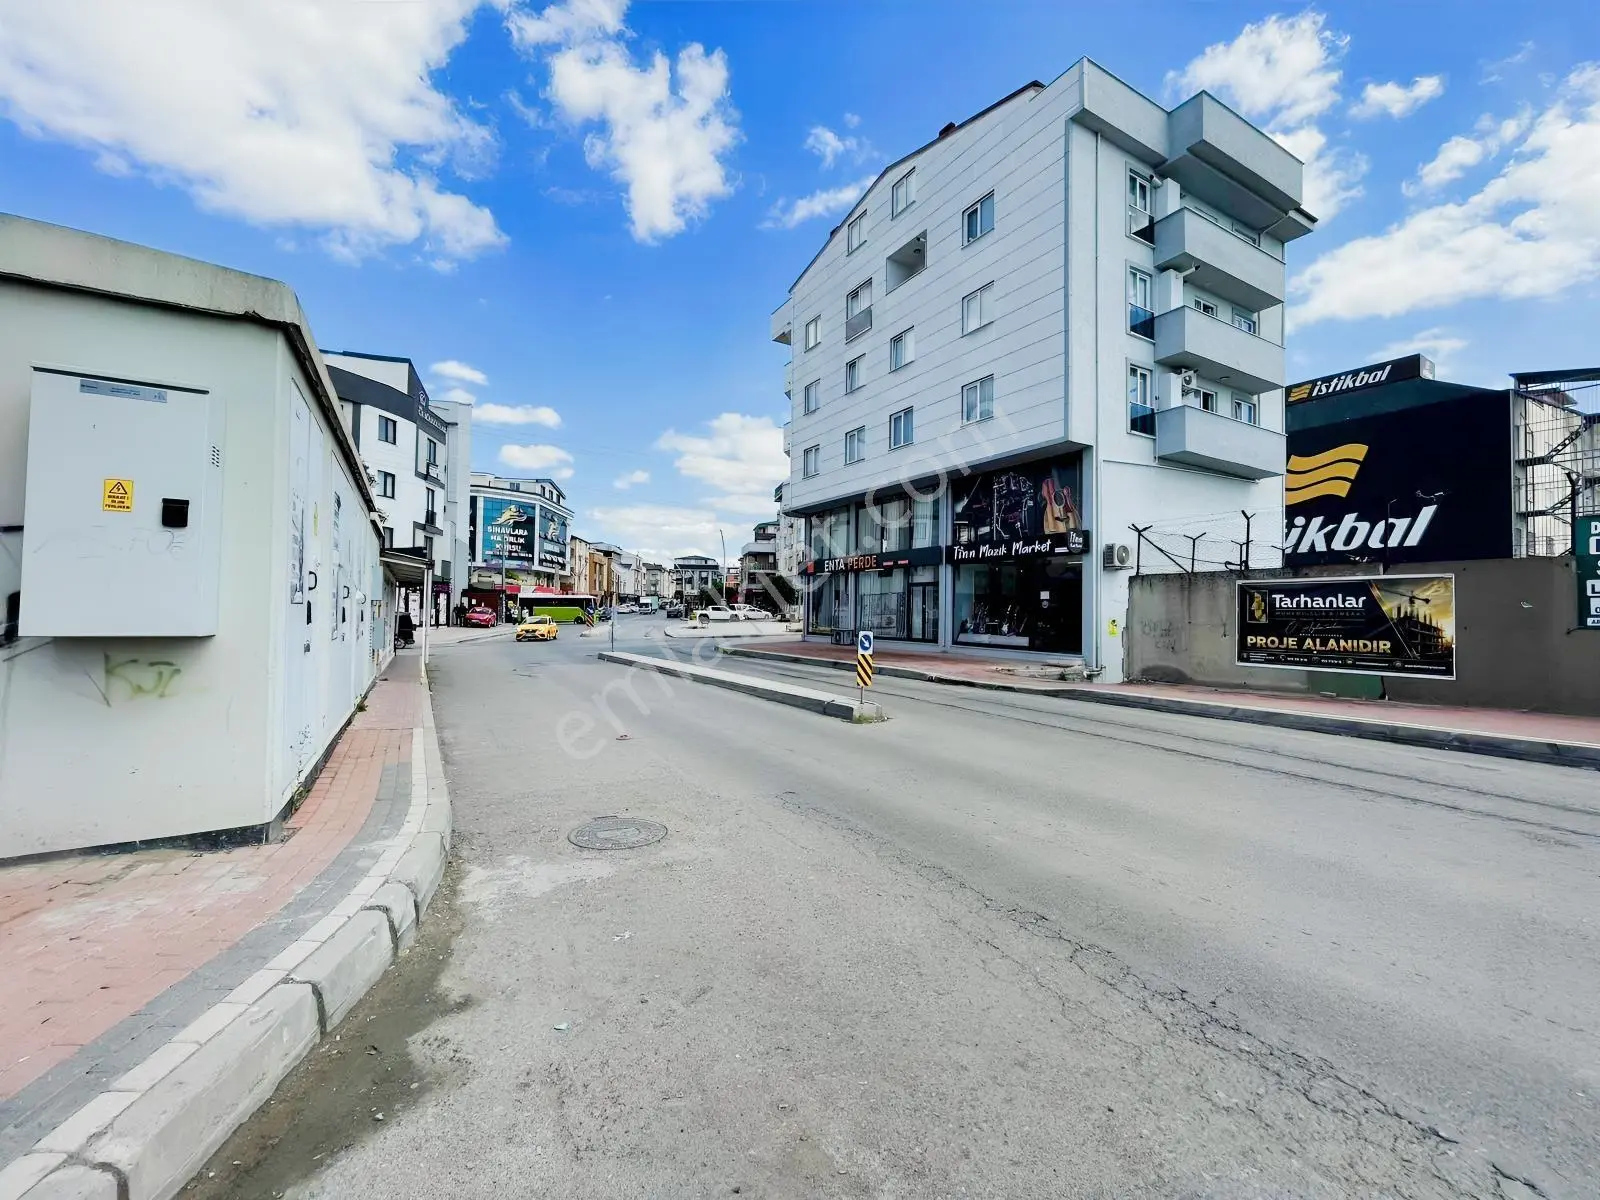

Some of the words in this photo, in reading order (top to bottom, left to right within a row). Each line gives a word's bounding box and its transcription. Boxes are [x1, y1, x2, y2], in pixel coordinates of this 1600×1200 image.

[1312, 365, 1392, 397] istikbal
[1285, 505, 1438, 554] ikbal
[1012, 539, 1052, 555] Market
[824, 558, 845, 572] ENTA
[847, 555, 877, 570] PERDE
[1271, 593, 1367, 608] Tarhanlar
[1246, 635, 1298, 649] PROJE
[1302, 637, 1392, 653] ALANIDIR
